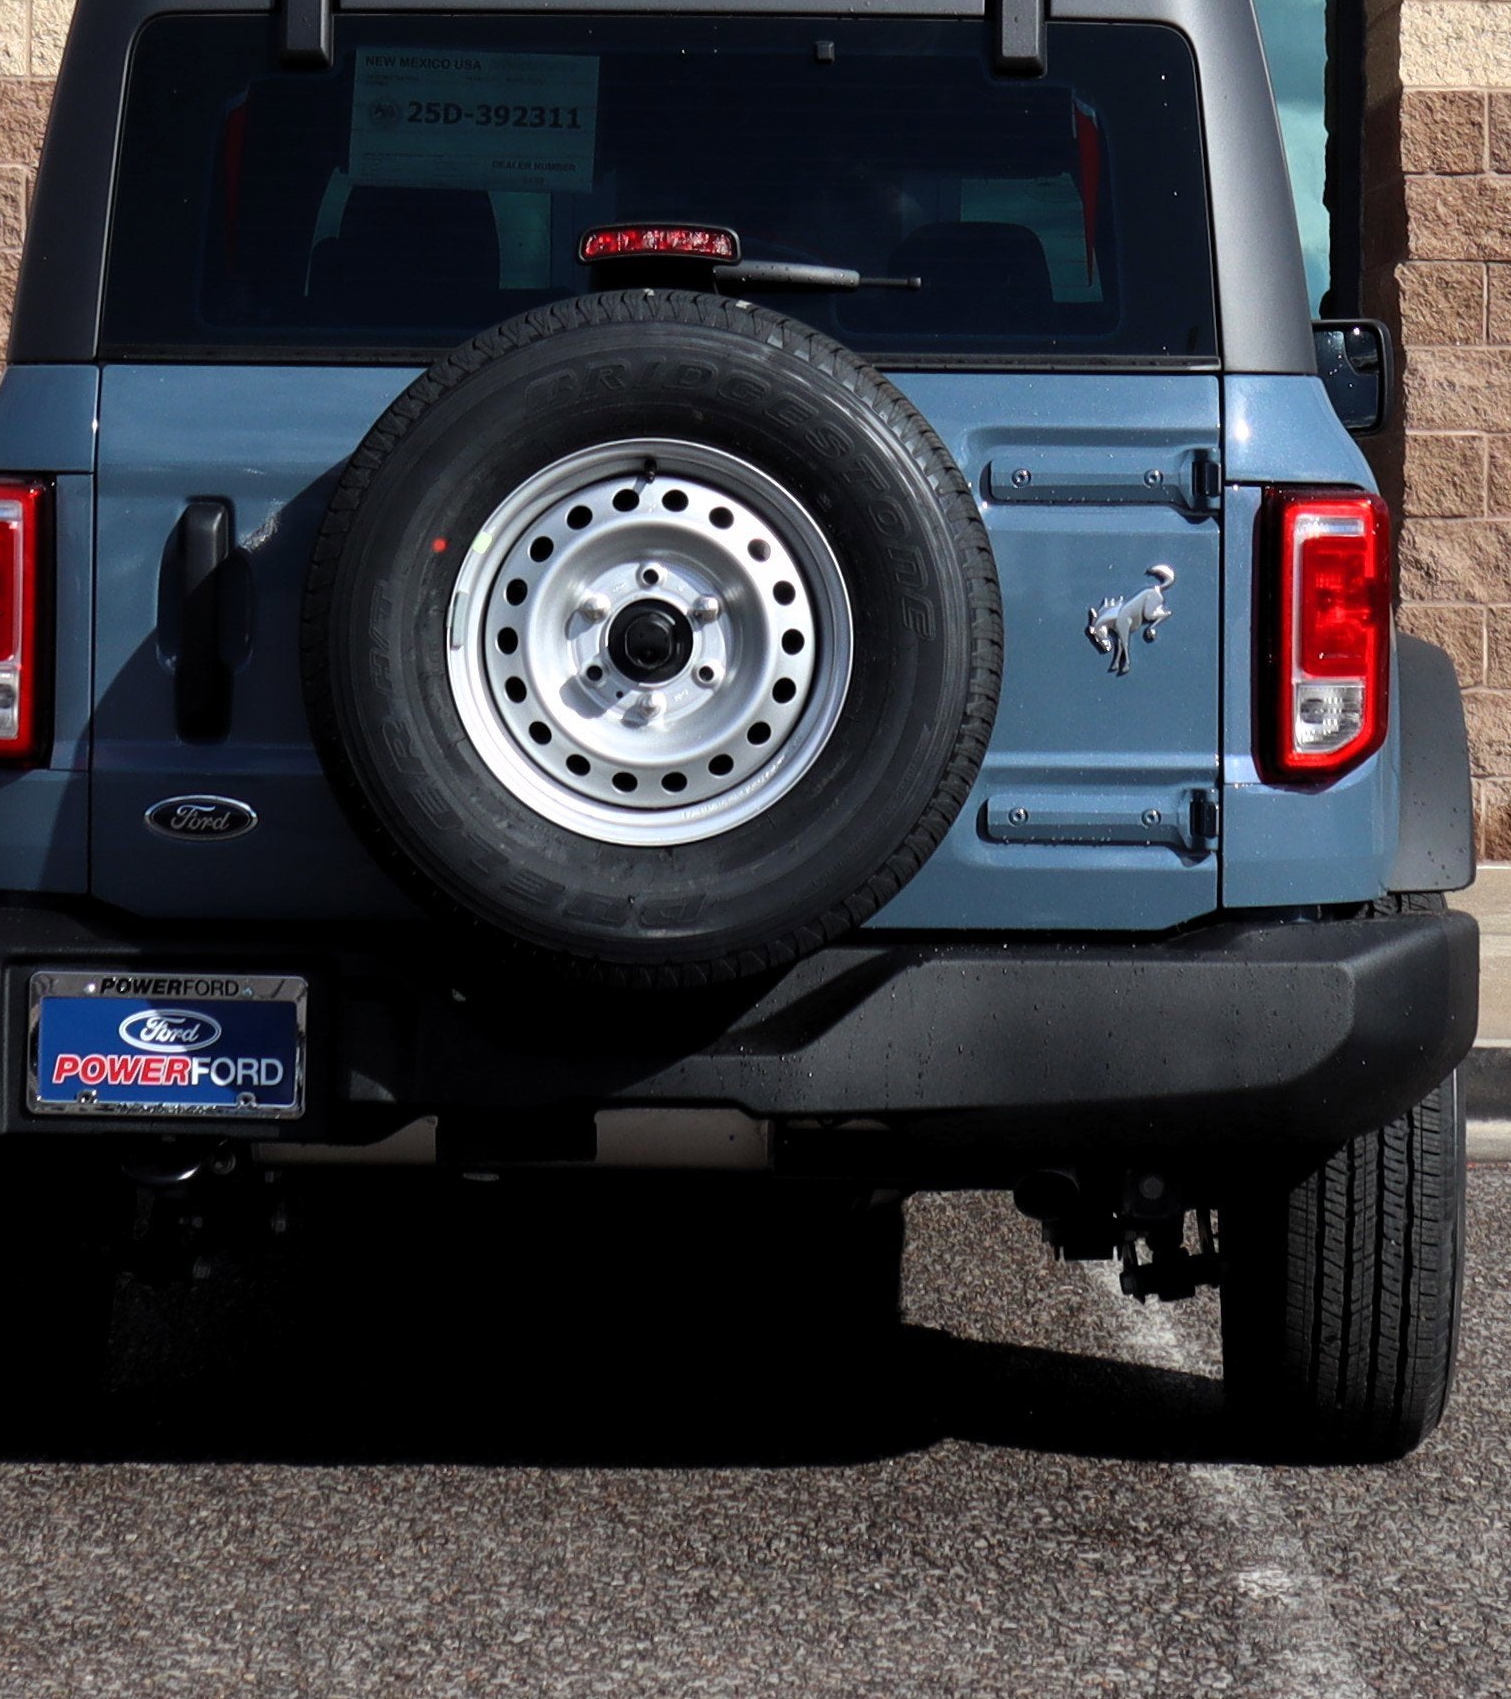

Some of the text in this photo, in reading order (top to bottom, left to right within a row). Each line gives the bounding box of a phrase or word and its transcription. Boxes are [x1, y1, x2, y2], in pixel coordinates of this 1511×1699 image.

[365, 56, 482, 71] NEW MEXICO USA
[406, 99, 582, 130] 25D-392311
[491, 159, 533, 171] DEALER
[521, 358, 937, 644] BRIDGESTONE
[170, 803, 231, 832] Ford
[100, 977, 240, 997] POWERFORD
[139, 1015, 201, 1044] Ford
[52, 1053, 284, 1087] POWERFORD
